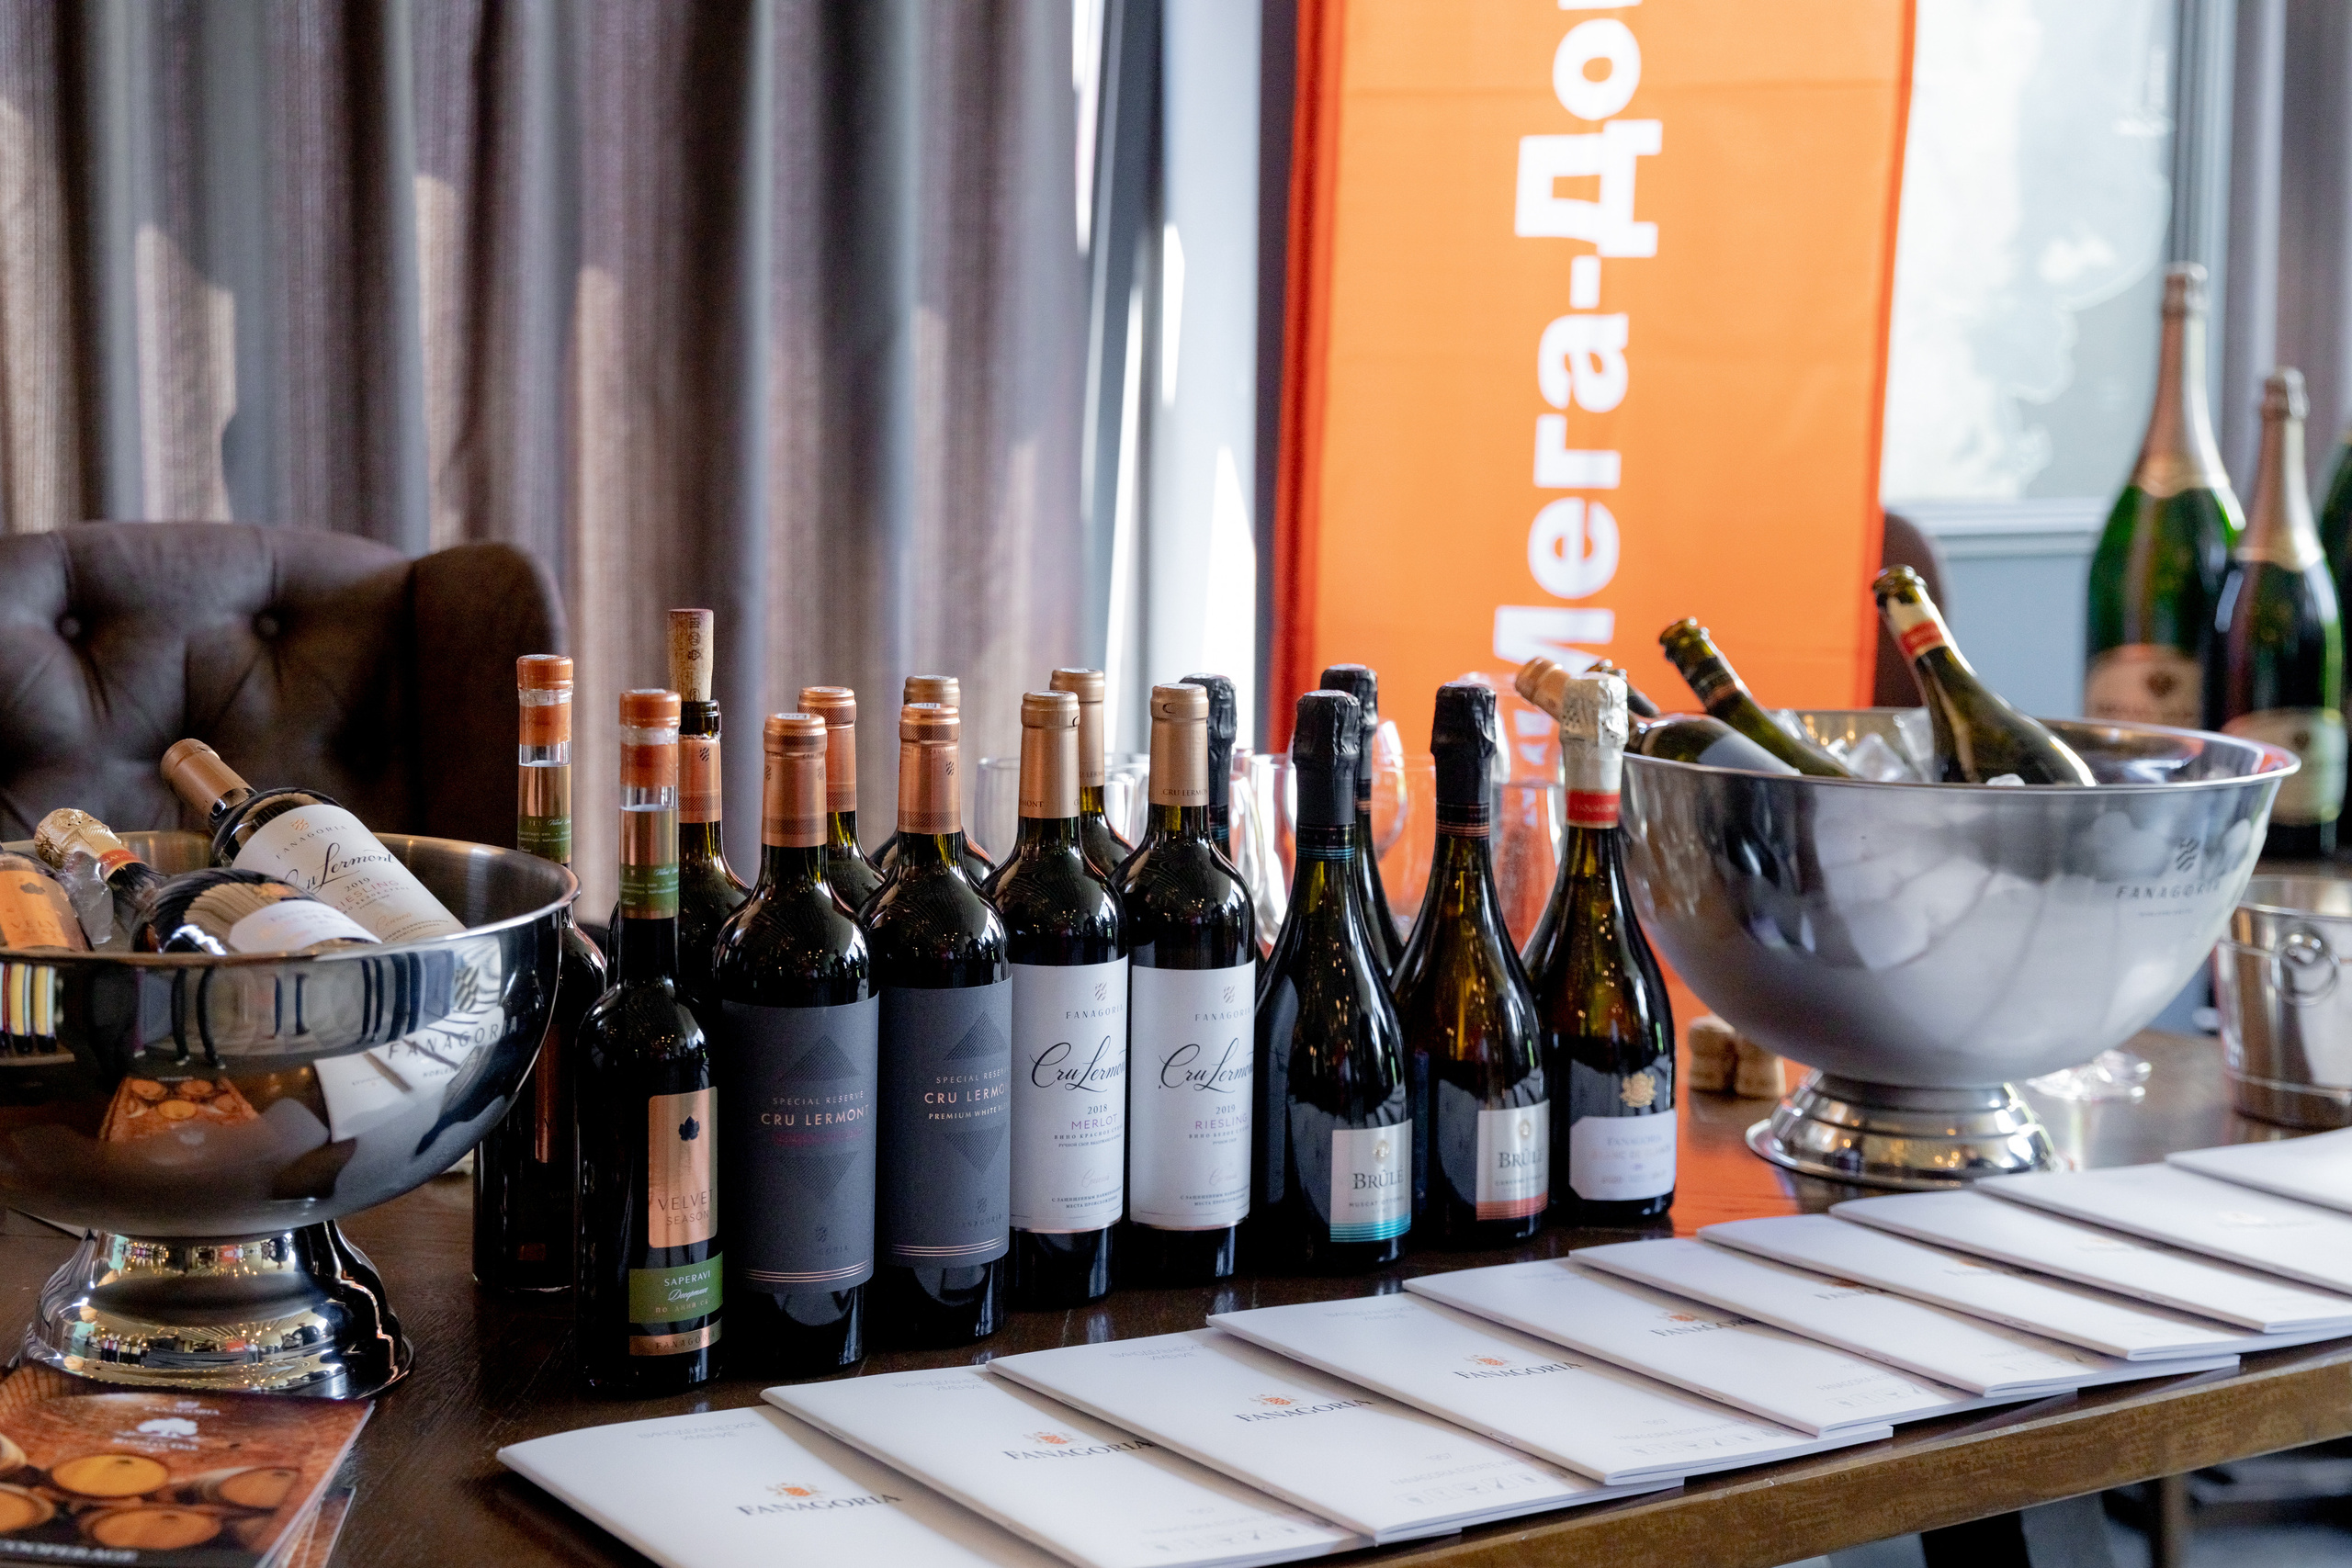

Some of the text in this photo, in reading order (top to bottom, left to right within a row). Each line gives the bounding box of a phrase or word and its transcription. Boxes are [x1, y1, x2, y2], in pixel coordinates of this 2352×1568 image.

[1492, 0, 1663, 684] Мега-До
[1066, 1004, 1123, 1020] FANAGORIA
[1194, 1007, 1250, 1021] FANAGORIA
[388, 1015, 518, 1060] FANAGORIA
[1029, 1042, 1081, 1089] Cru
[1159, 1043, 1209, 1089] Cru
[936, 1075, 979, 1084] SPECIAL
[773, 1090, 864, 1106] SPECIAL RESERVE
[924, 1092, 957, 1104] CRU
[761, 1104, 869, 1126] CRU LERMONT
[928, 1111, 972, 1121] PREMIUM
[974, 1106, 997, 1117] WHITE
[1088, 1103, 1108, 1115] 2018
[1216, 1104, 1236, 1115] 2019
[1071, 1113, 1118, 1130] MERLOT
[1195, 1112, 1248, 1130] RIESLING
[658, 1190, 714, 1212] VELVET
[664, 1269, 711, 1286] SAPERAVI
[1452, 1361, 1585, 1379] FANAGORIA
[1234, 1399, 1374, 1423] FANAGORIA
[1002, 1439, 1155, 1461] FANAGORIA
[736, 1493, 901, 1516] FANAGORIA
